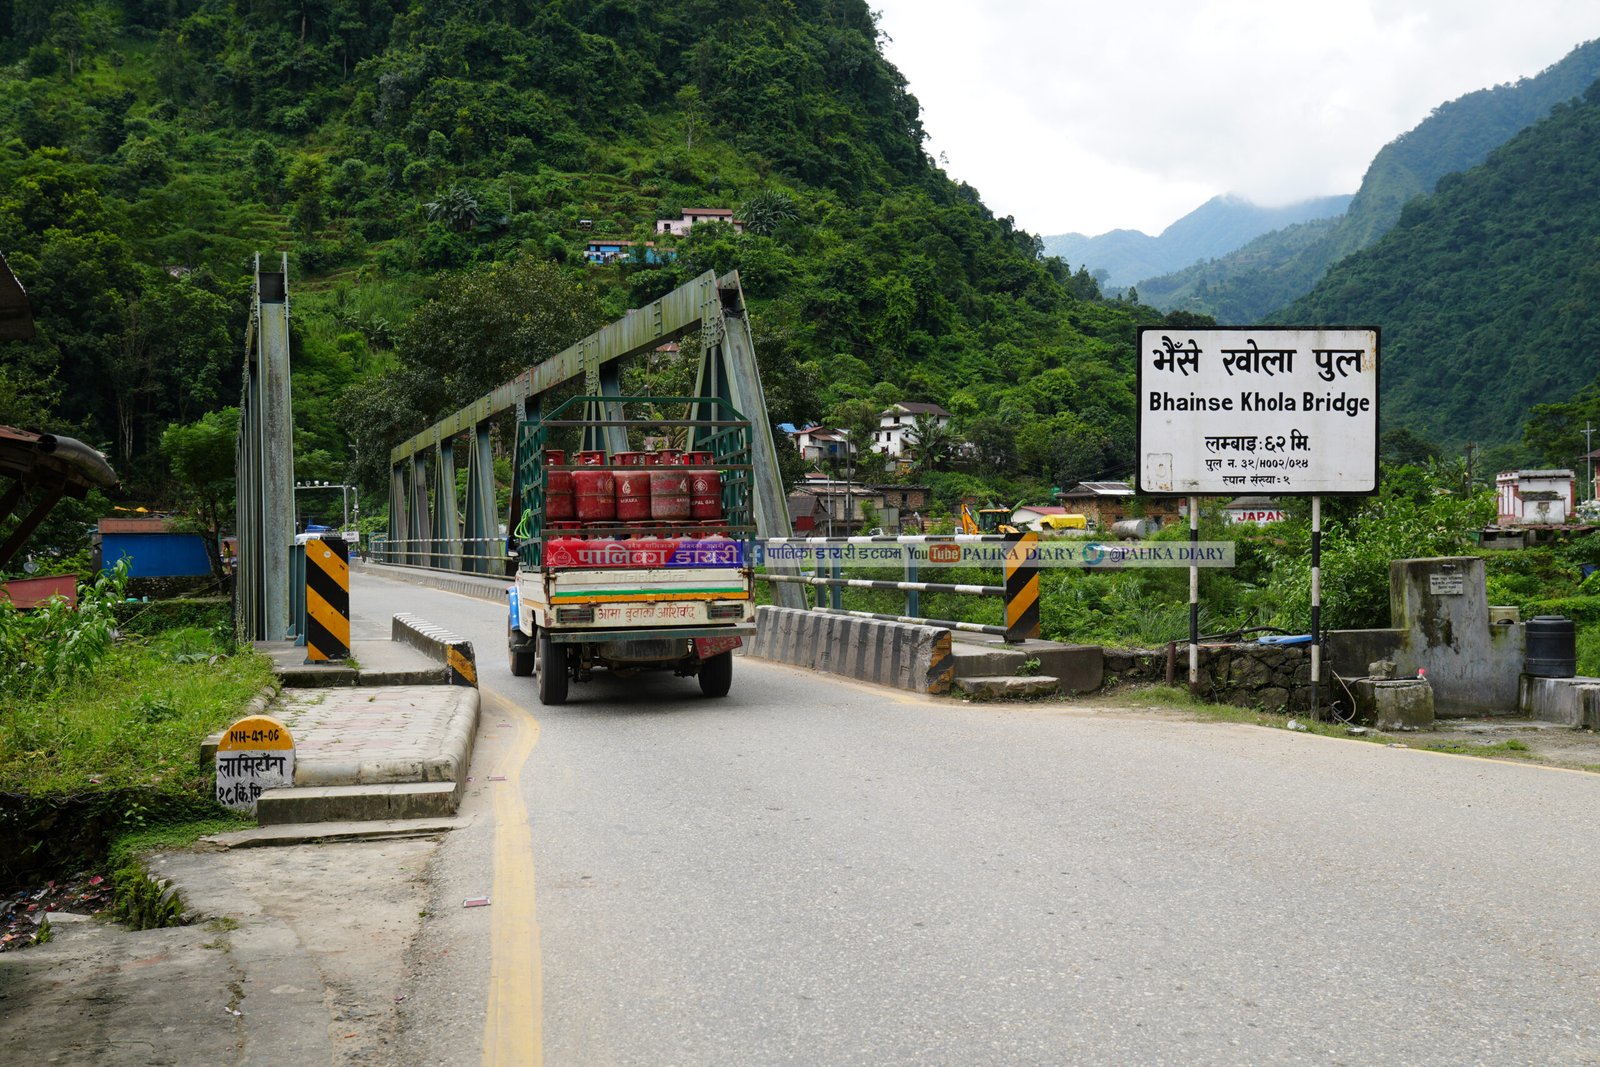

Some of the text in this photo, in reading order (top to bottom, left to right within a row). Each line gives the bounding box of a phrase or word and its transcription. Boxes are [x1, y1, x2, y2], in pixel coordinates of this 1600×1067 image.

[1221, 339, 1297, 376] खोला
[1312, 349, 1365, 382] पुल
[1150, 392, 1370, 417] Bhainse Khola Bridge
[1205, 459, 1222, 471] पुल
[230, 729, 279, 743] NH-41-06
